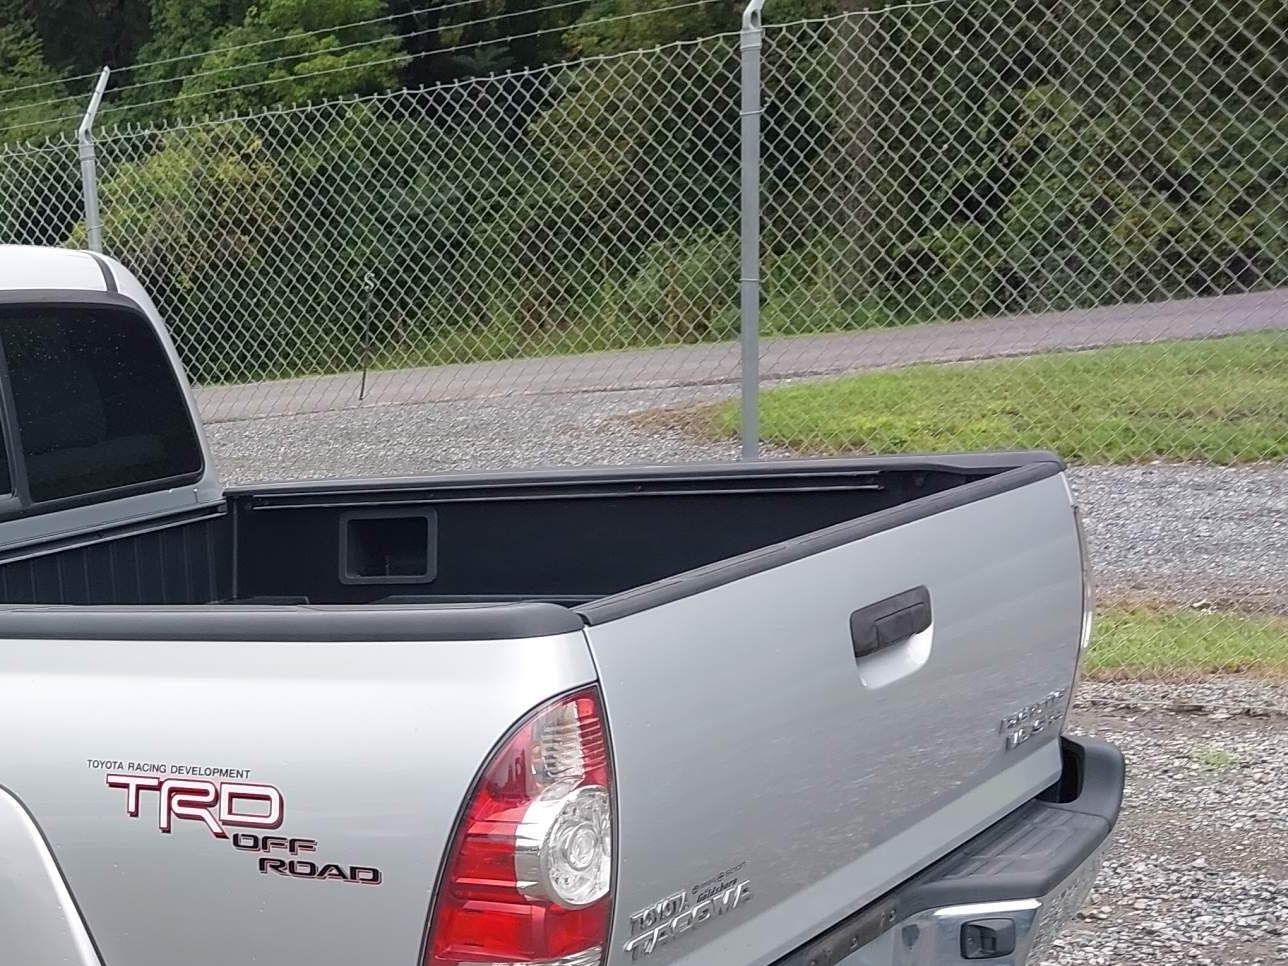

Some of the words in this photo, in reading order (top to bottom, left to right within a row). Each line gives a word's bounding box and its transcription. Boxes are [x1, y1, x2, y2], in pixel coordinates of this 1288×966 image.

[87, 759, 124, 771] TOYOTA
[128, 762, 167, 774] RACING
[170, 764, 251, 780] DEVELOPMENT
[105, 773, 285, 839] TRD
[232, 832, 318, 855] OFF
[258, 856, 383, 885] ROAD
